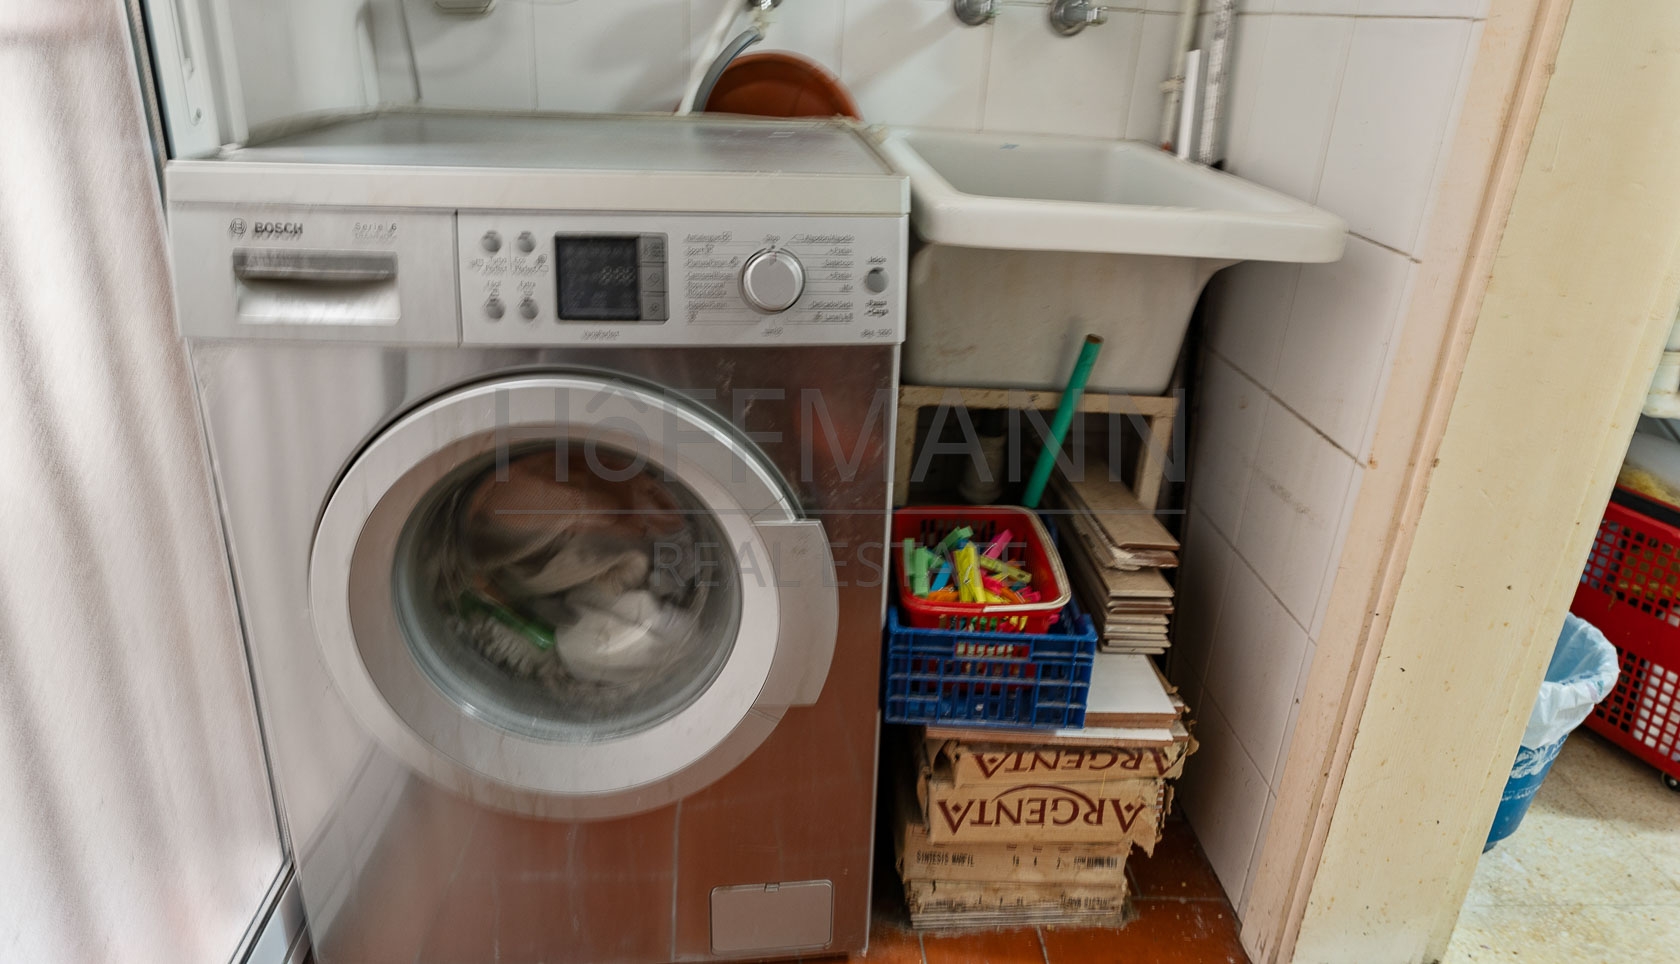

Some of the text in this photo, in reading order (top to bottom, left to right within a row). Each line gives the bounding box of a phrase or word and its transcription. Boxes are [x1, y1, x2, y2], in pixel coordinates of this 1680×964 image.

[254, 221, 304, 235] BOSCH
[972, 751, 1174, 778] ARGENTA
[938, 797, 1146, 835] ARGENTA
